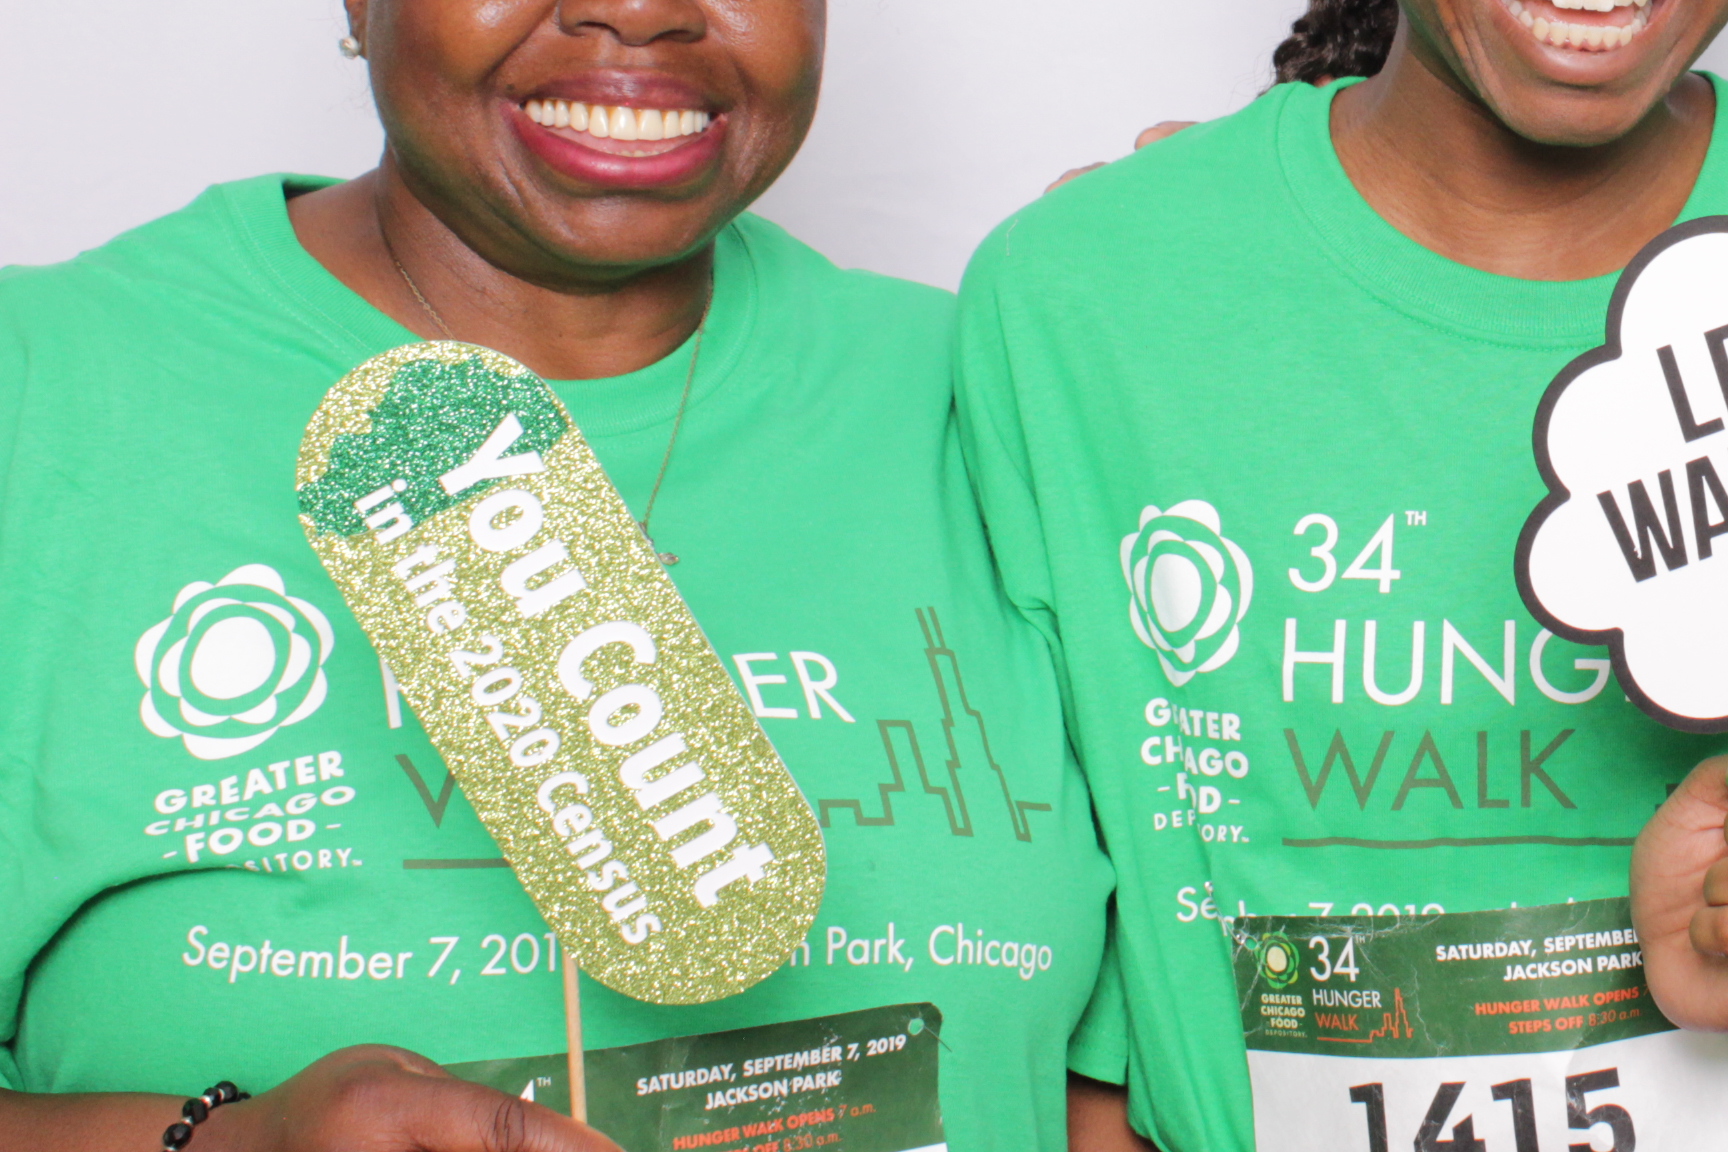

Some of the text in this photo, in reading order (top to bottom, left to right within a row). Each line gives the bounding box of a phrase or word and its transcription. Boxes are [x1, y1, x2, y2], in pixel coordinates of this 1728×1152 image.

[437, 411, 776, 909] You Count
[1281, 617, 1631, 707] HUNG
[353, 478, 662, 945] in the 2020 Census
[1140, 735, 1249, 779] CHAGO
[1282, 727, 1579, 812] WALK
[154, 750, 344, 815] GREATER
[143, 785, 356, 836] CHICAGO
[184, 818, 316, 864] FOOD
[182, 925, 557, 985] September 7, 201
[826, 922, 914, 972] Park,
[929, 922, 1053, 981] Chicago
[1435, 939, 1537, 962] SATURDAY,
[1503, 951, 1644, 982] JACKSON PARK
[1260, 992, 1303, 1005] GREATER
[1260, 1005, 1306, 1018] CHICAGO
[1312, 988, 1382, 1008] HUNGER
[1474, 998, 1541, 1016] HUNGER
[1543, 994, 1591, 1011] WALK
[1592, 986, 1640, 1006] OPENS
[1269, 1016, 1299, 1029] FOOD
[1315, 1011, 1360, 1031] WALK
[1508, 1018, 1552, 1035] STEPS
[1554, 1016, 1584, 1031] OFF
[1588, 1010, 1617, 1027] 8:30
[636, 1034, 907, 1096] SATURDAY, SEPTEMBER 7, 2019
[704, 1070, 842, 1111] JACKSON PARK
[1349, 1066, 1637, 1152] 1415
[673, 1127, 741, 1151] HUNGER
[742, 1118, 784, 1138] WALK
[787, 1108, 835, 1129] OPENS
